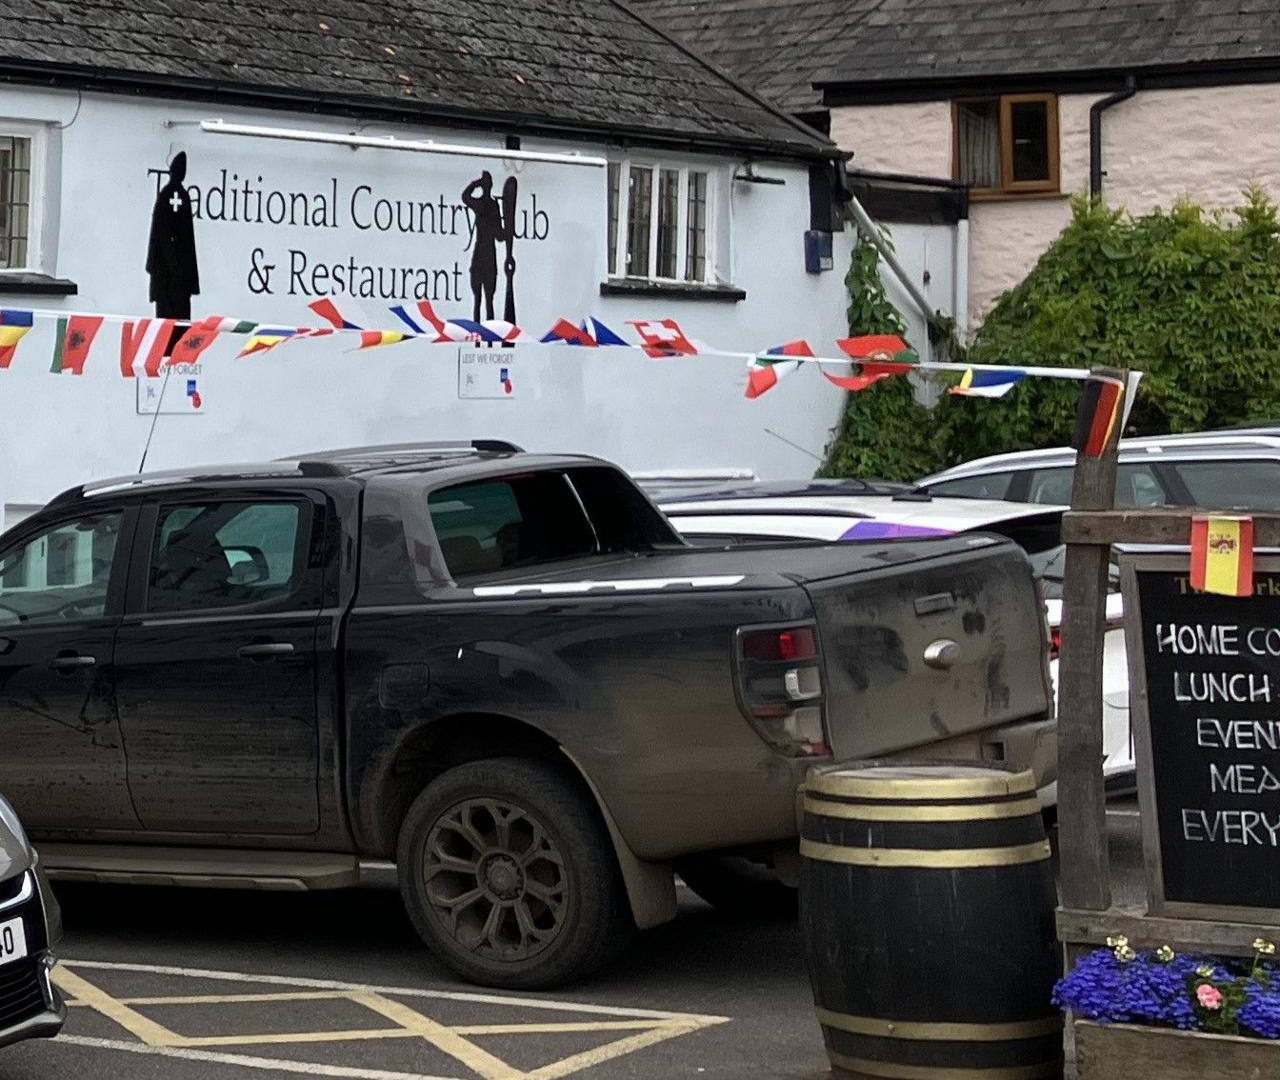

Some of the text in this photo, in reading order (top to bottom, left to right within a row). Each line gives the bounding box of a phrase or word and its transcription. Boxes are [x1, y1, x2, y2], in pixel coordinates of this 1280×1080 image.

[147, 169, 338, 228] Taditional
[350, 185, 477, 252] Country
[247, 247, 463, 301] & Restaurant
[1156, 623, 1239, 655] HOME
[1174, 672, 1271, 703] LUNCH
[1182, 808, 1280, 847] EVERY
